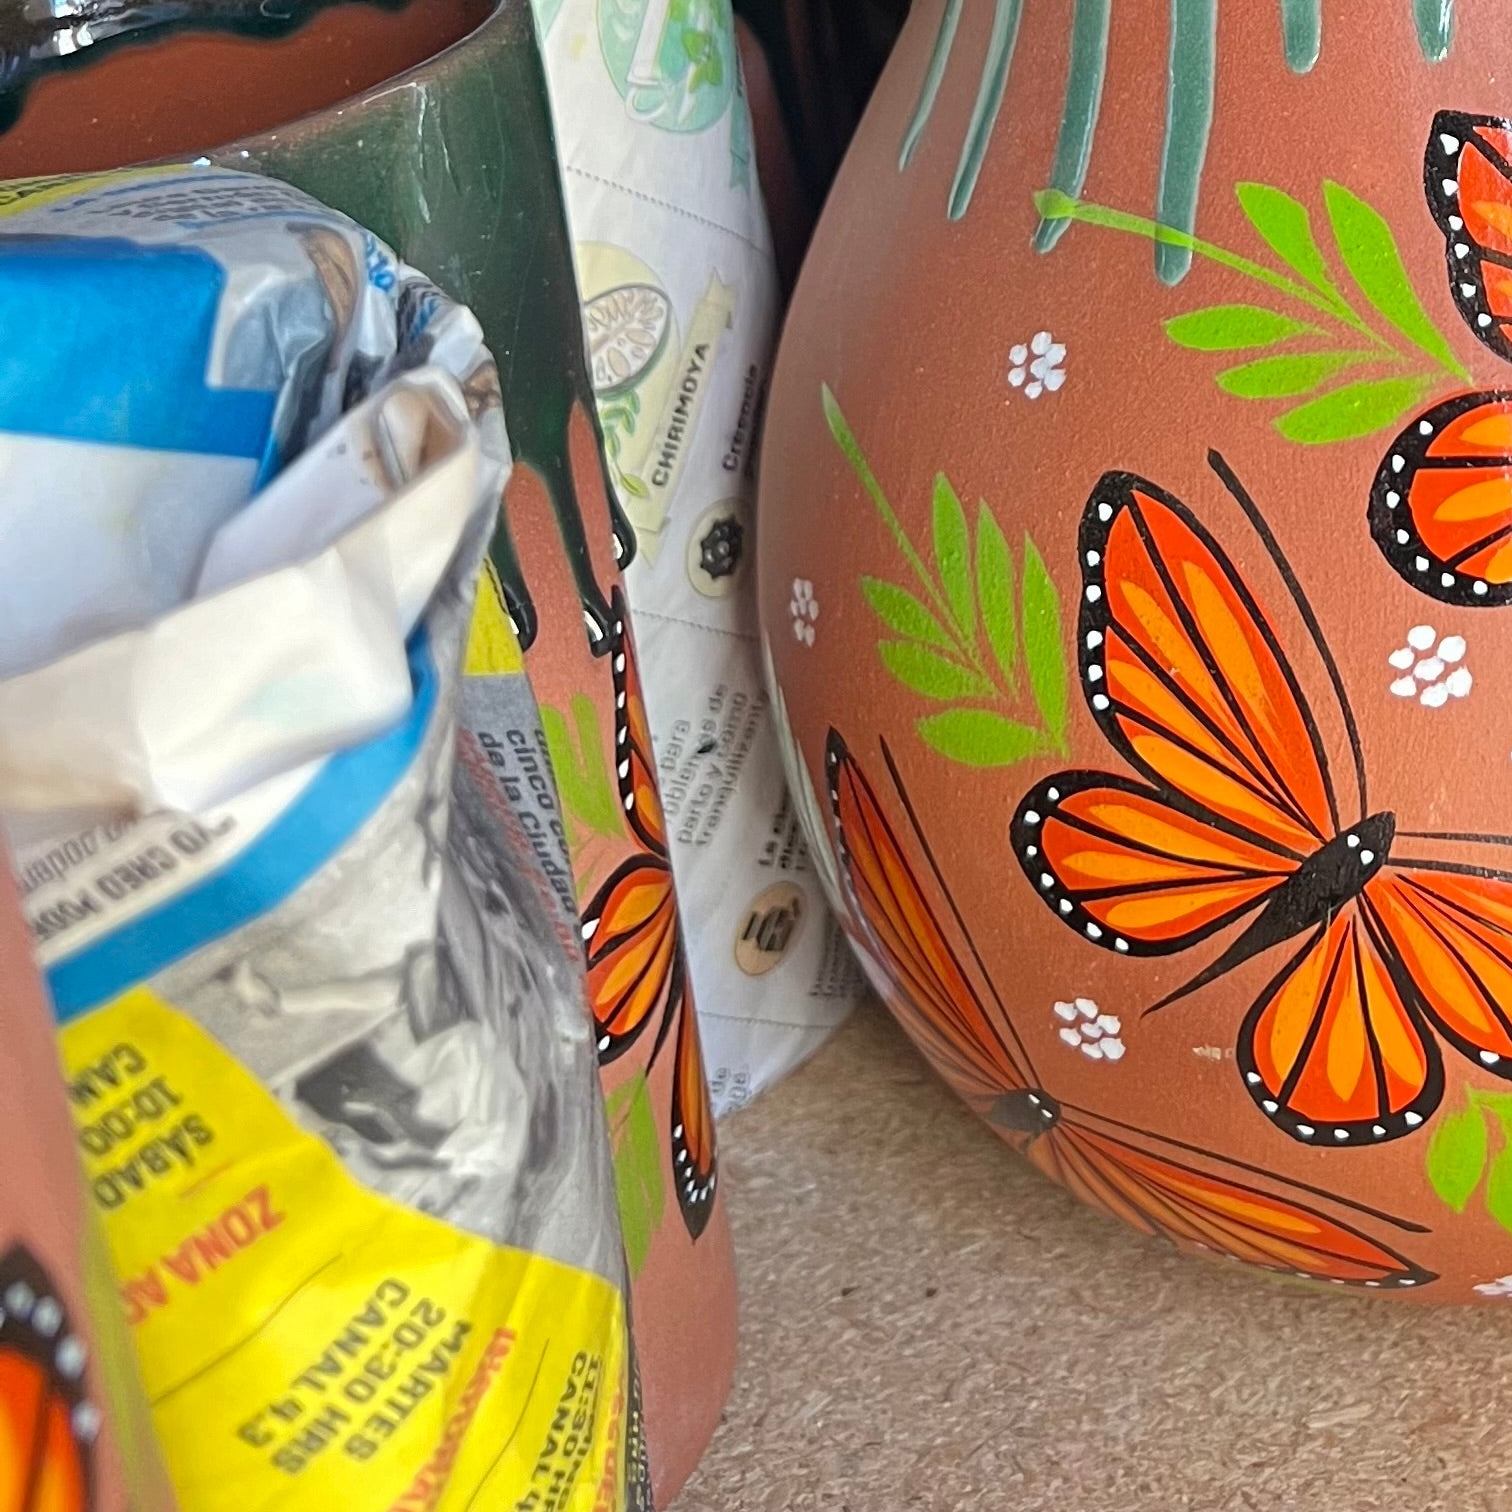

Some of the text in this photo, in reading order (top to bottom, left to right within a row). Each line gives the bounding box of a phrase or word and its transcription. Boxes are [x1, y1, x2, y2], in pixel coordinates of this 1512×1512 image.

[651, 343, 710, 487] CHIRIMOYA
[478, 731, 505, 767] de
[499, 775, 521, 801] la
[506, 729, 554, 809] cinco
[167, 1182, 286, 1284] ZONA
[291, 1278, 411, 1391] CANAL
[340, 1296, 447, 1404] 20:30
[270, 1407, 355, 1476] HRS
[341, 1318, 473, 1461] MARTES
[530, 1350, 586, 1482] CANAL
